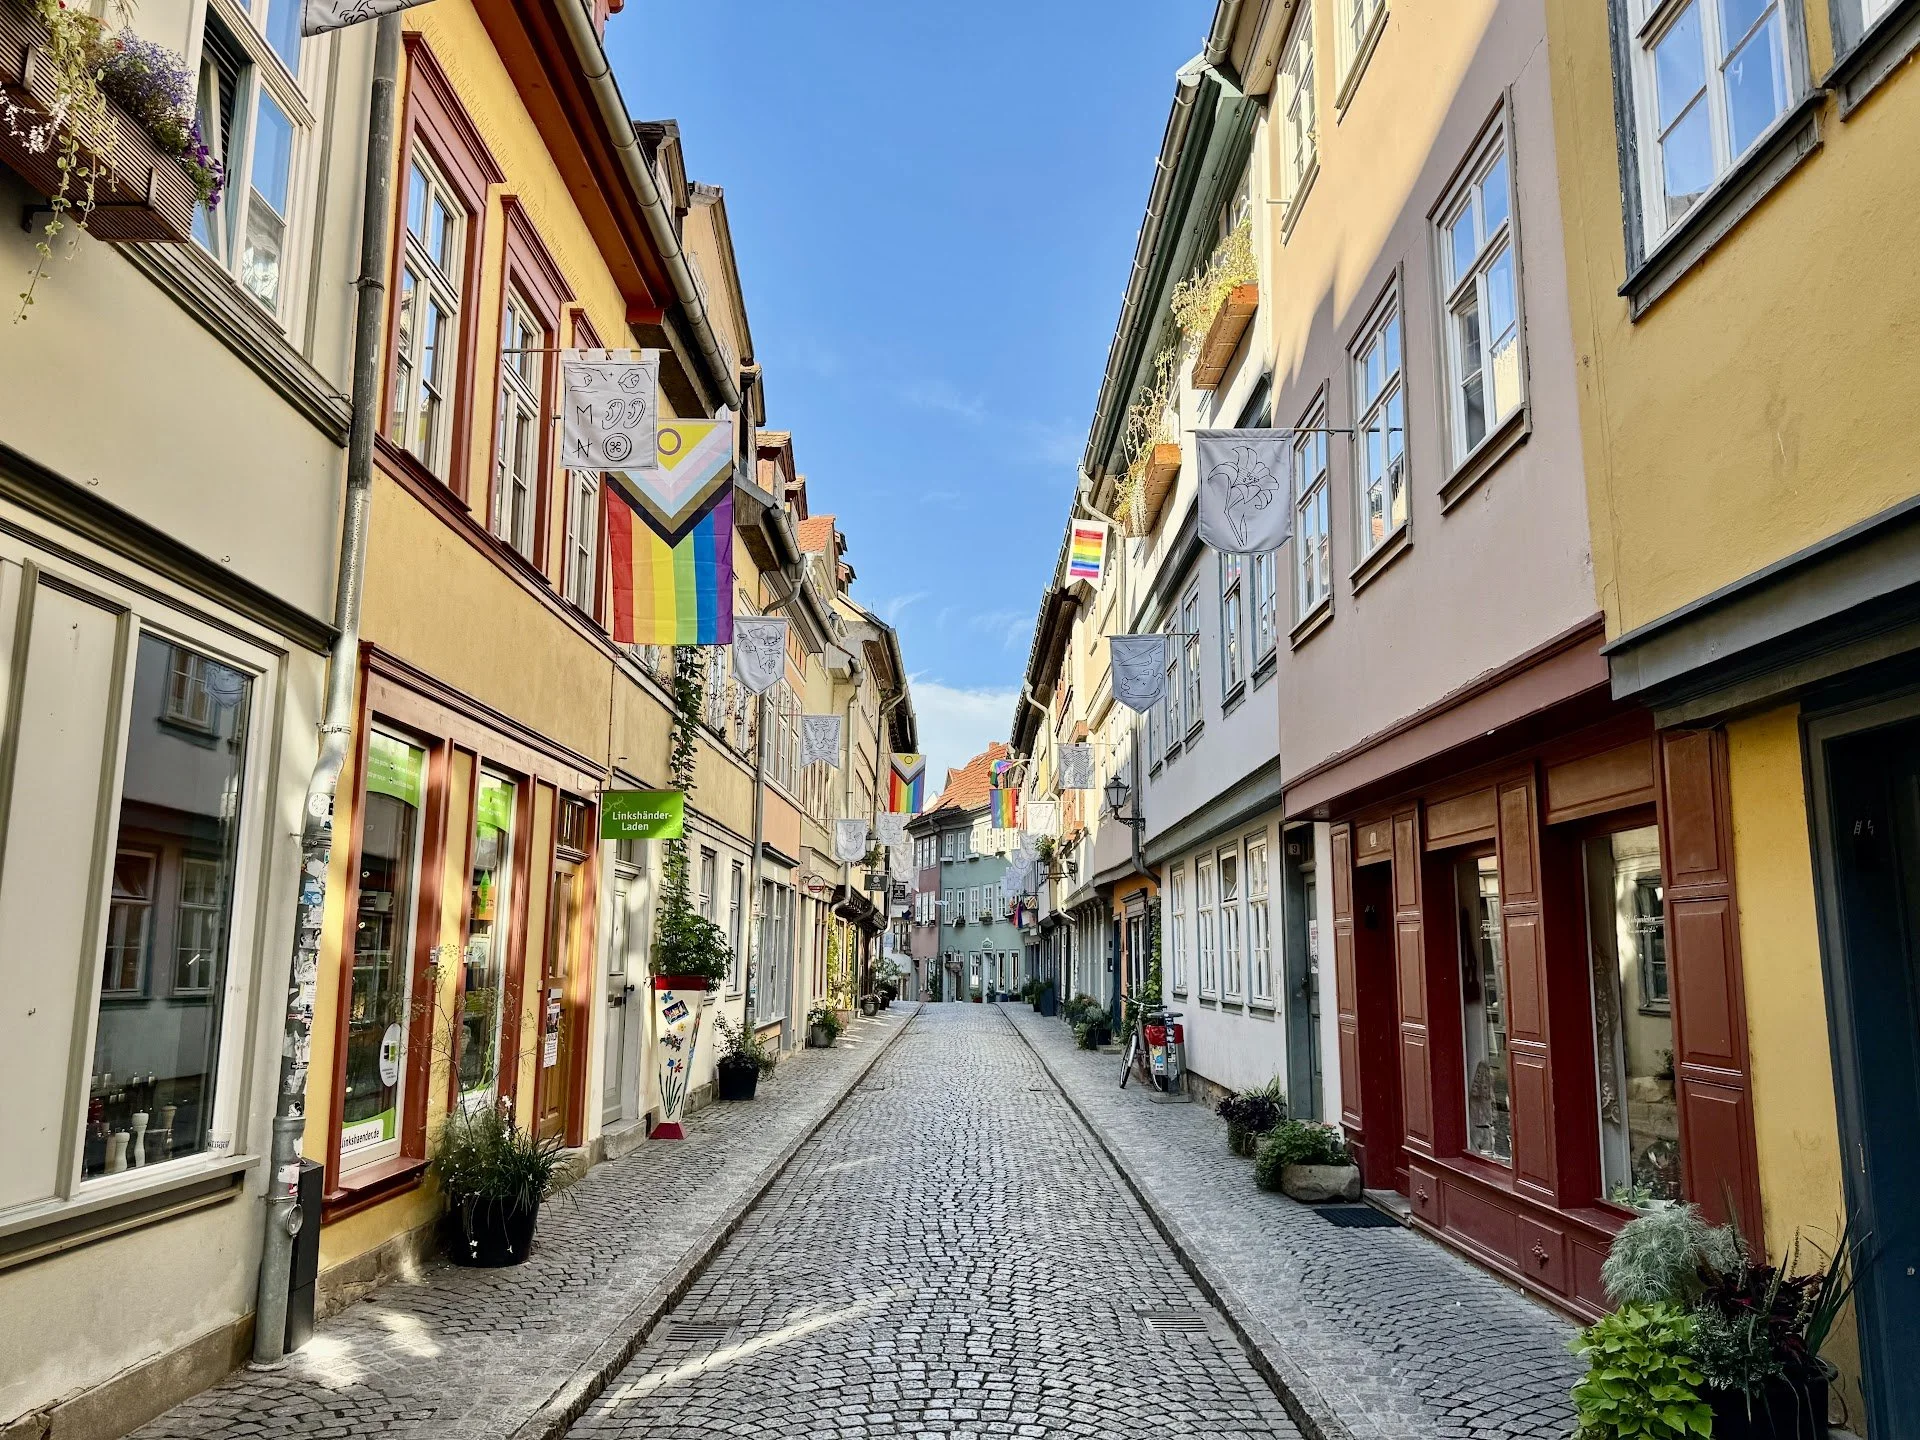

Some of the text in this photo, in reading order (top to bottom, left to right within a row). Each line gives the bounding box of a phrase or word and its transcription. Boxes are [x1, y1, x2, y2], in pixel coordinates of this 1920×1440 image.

[576, 404, 593, 425] M
[613, 811, 672, 820] Linkshänder-
[622, 822, 649, 831] Laden
